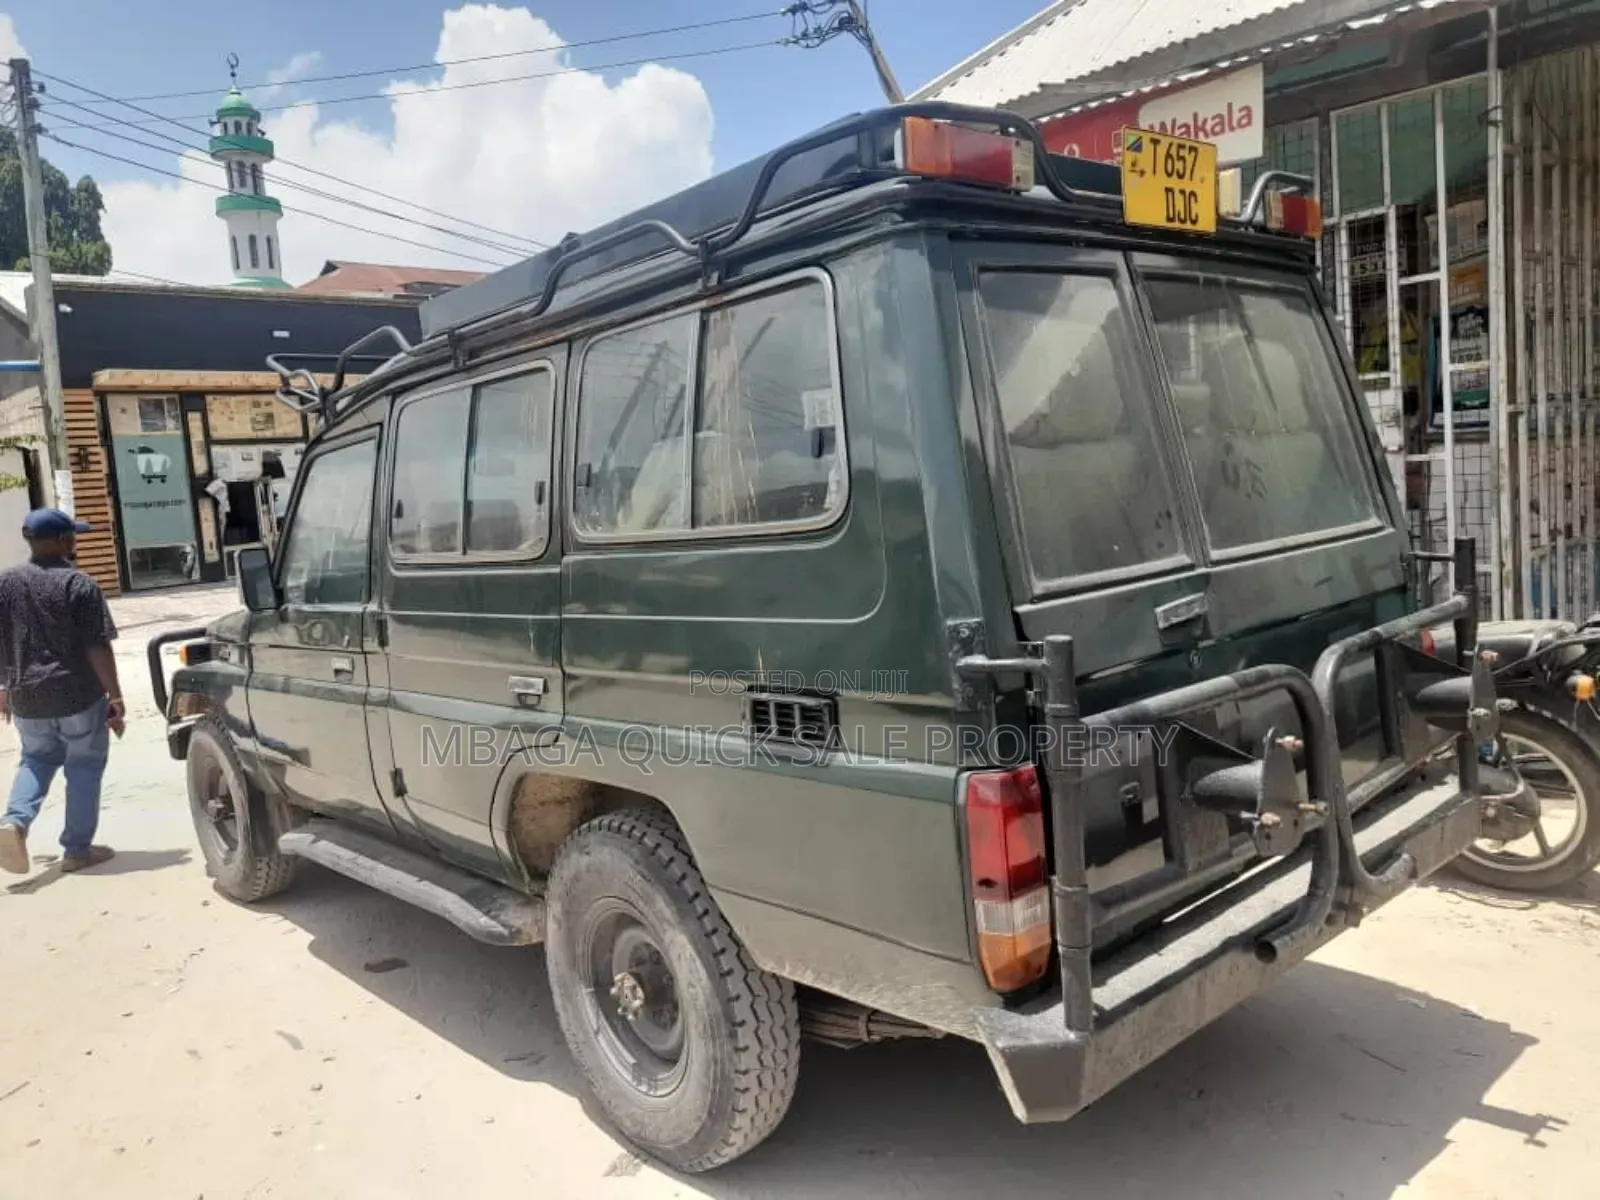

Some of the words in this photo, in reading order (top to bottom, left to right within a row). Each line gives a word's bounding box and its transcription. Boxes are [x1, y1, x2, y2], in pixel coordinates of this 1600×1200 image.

[1148, 102, 1254, 141] Wakala
[1149, 138, 1161, 177] T
[1164, 141, 1199, 181] 657
[1165, 186, 1199, 225] DJC
